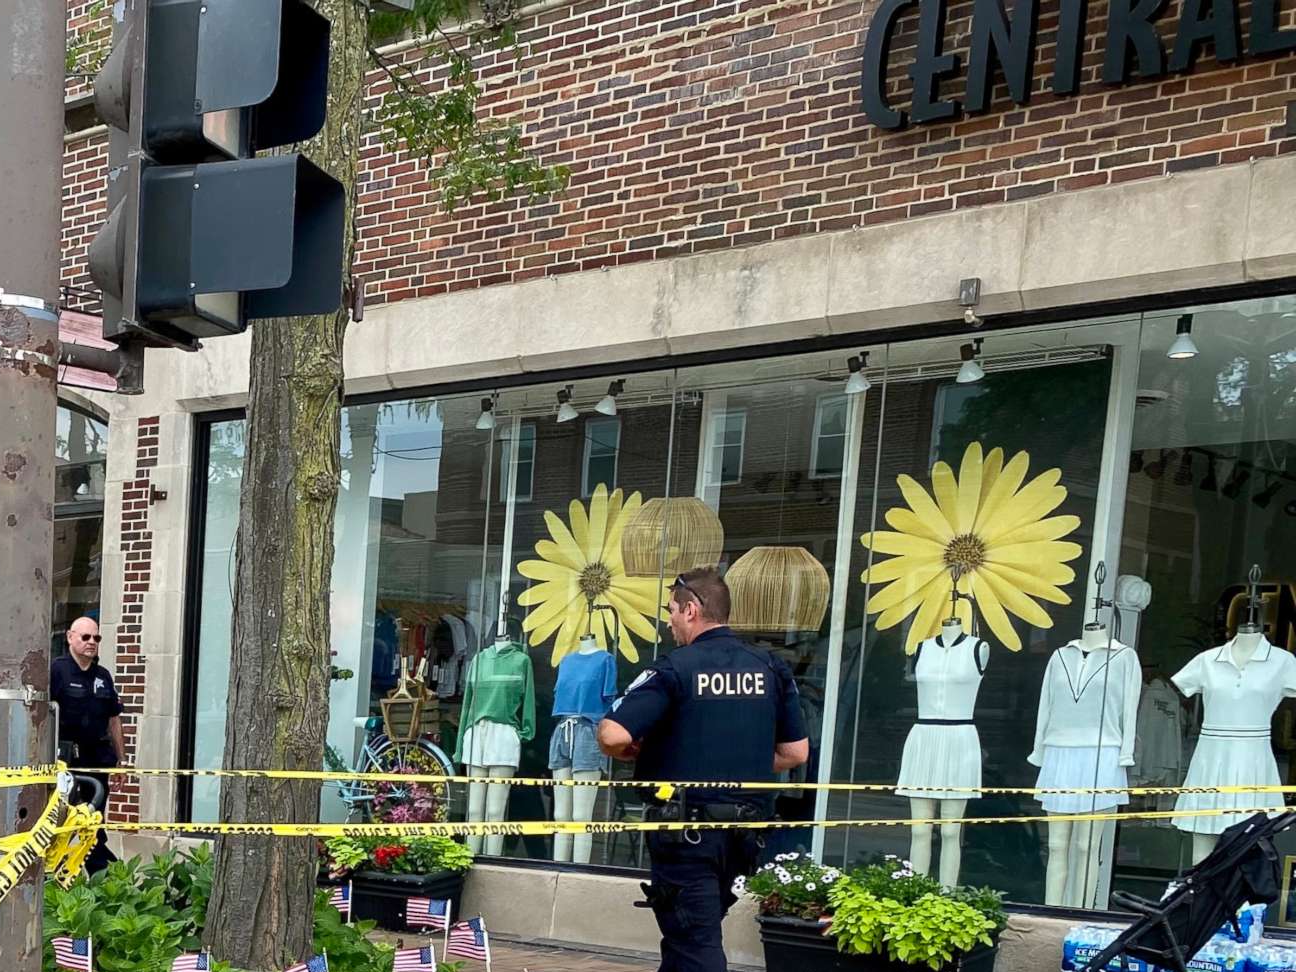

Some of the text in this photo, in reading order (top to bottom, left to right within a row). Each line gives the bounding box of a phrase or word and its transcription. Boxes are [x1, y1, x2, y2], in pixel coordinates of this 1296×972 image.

[697, 672, 765, 695] POLICE
[343, 823, 524, 838] POLICE LINE DO NOT CROSS
[8, 842, 37, 878] NOT
[1074, 947, 1086, 956] ICE
